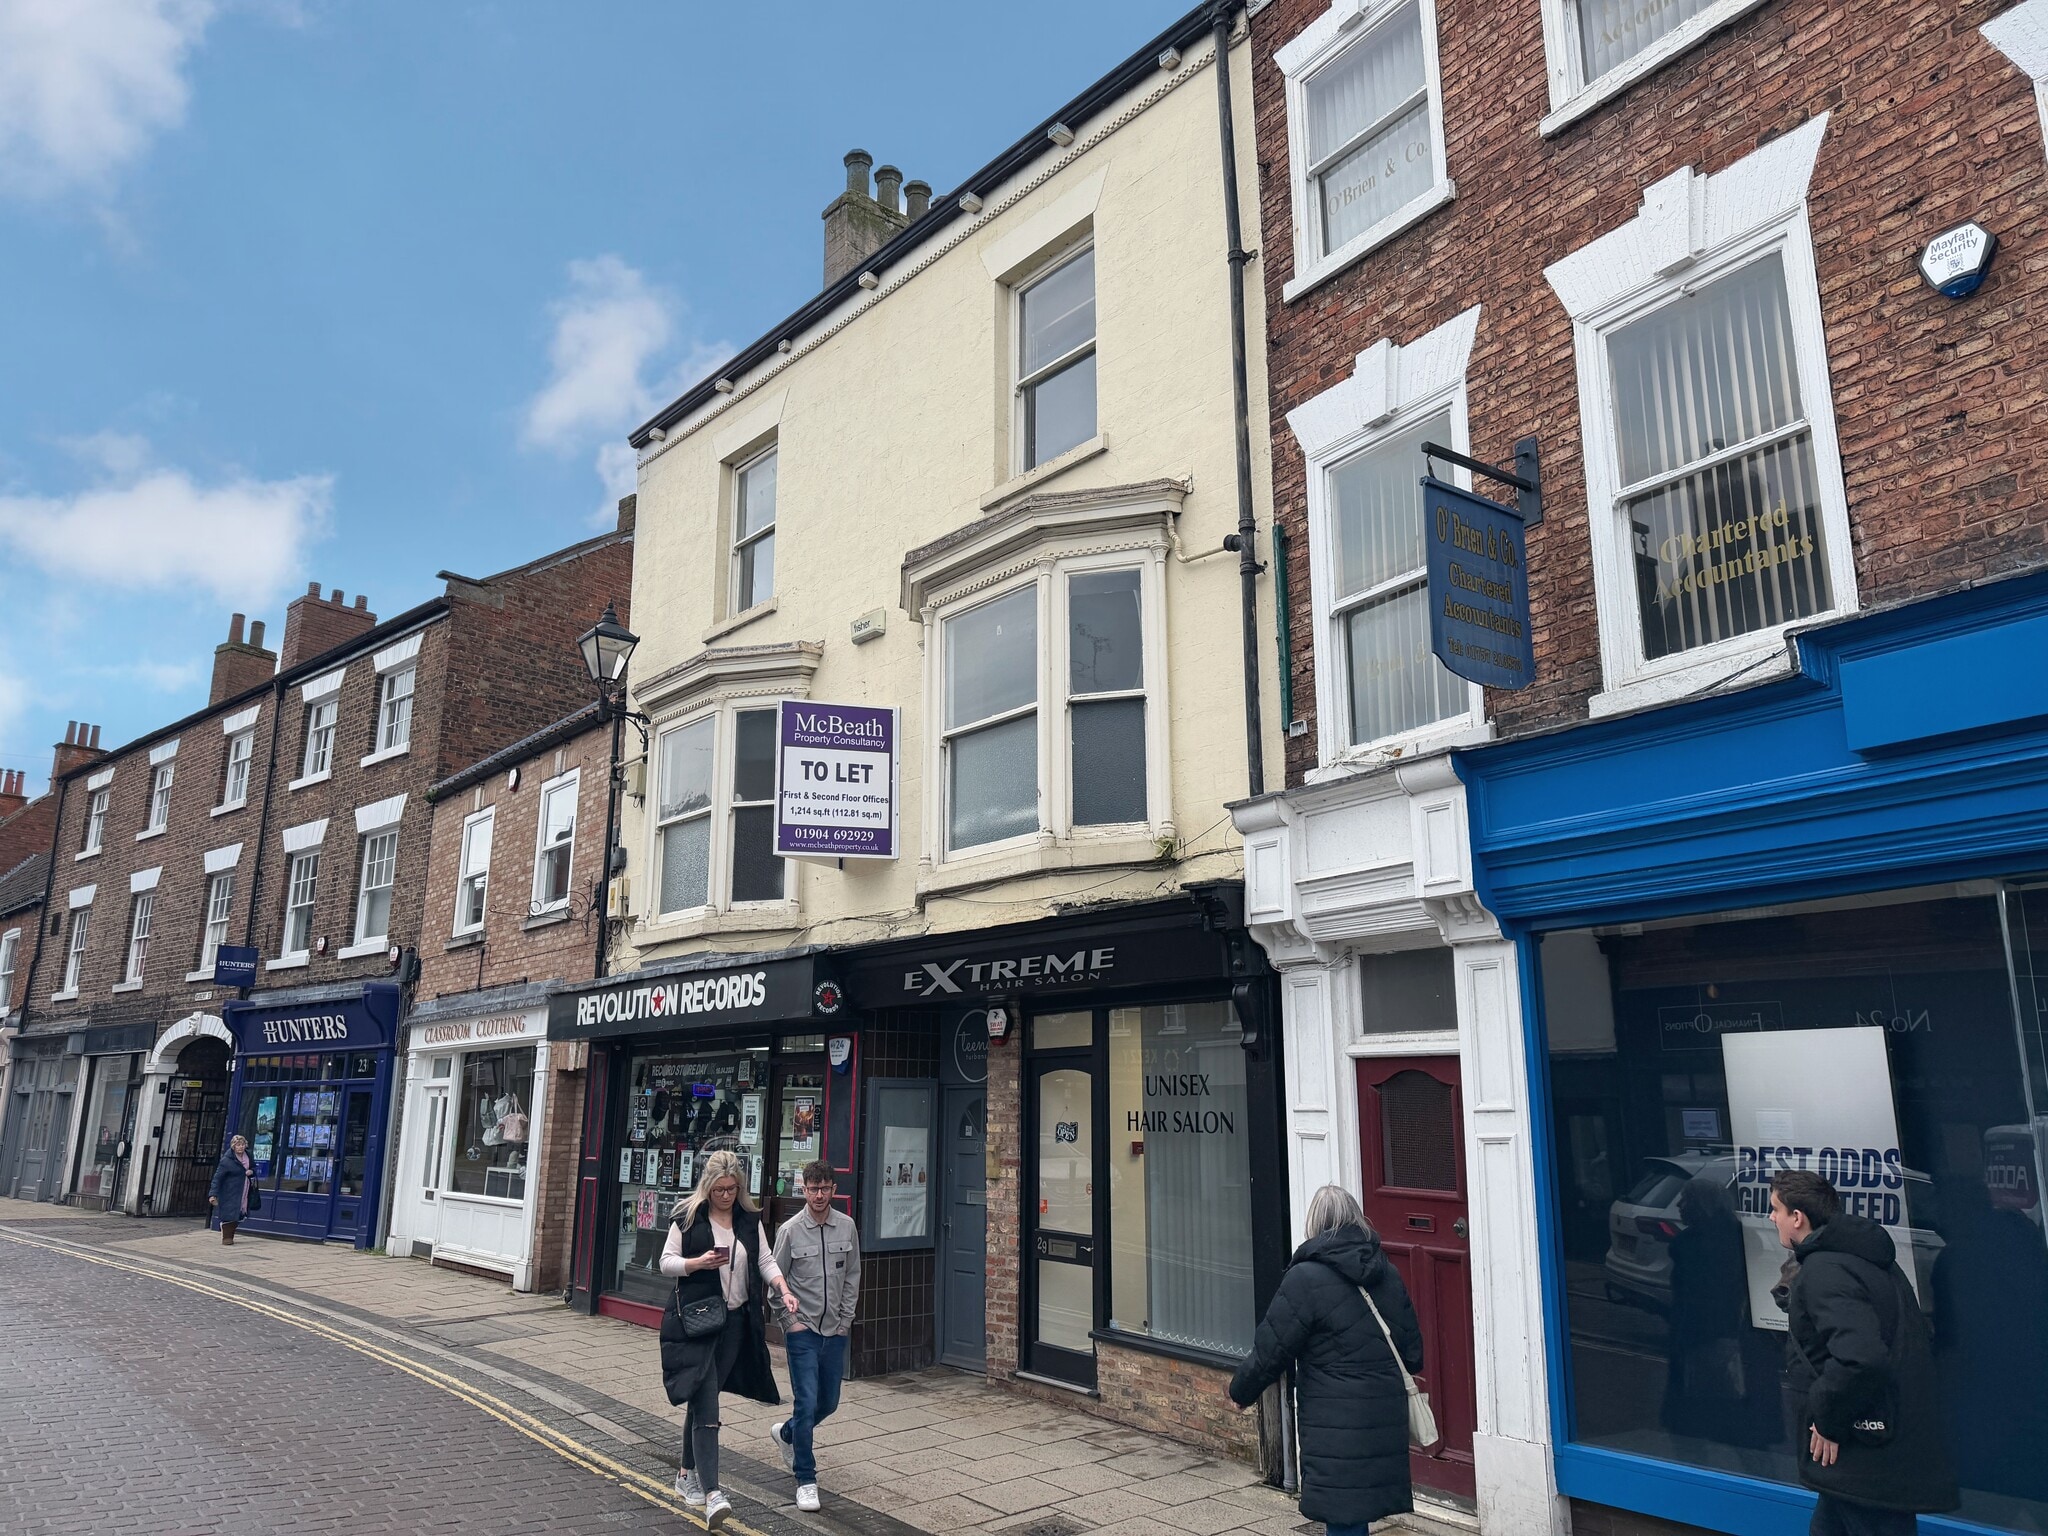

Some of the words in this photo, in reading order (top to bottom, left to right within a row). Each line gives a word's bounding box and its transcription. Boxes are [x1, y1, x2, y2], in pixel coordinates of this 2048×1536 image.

[1328, 175, 1376, 216] O'Brien
[1385, 157, 1396, 178] &
[1405, 142, 1428, 163] Co.
[1930, 238, 1978, 264] Security
[1931, 228, 1975, 254] Mayfair
[1660, 498, 1789, 563] Chartered
[1487, 524, 1497, 561] &
[1500, 529, 1518, 569] Co.
[1652, 533, 1814, 605] Accountants
[1449, 562, 1512, 604] Chartered
[1444, 594, 1522, 639] Accountants
[795, 712, 884, 737] McBeath
[794, 733, 831, 745] Property
[833, 736, 885, 749] Consultancy
[801, 760, 828, 781] TO
[835, 763, 873, 784] LET
[784, 791, 801, 800] First
[804, 792, 809, 800] &
[812, 792, 840, 802] Second
[842, 794, 861, 803] Floor
[863, 795, 889, 804] Offices
[790, 806, 811, 816] 1,214
[813, 807, 830, 817] sq.ft
[862, 810, 882, 820] sq.m)
[795, 828, 829, 840] 01904
[834, 830, 874, 841] 692929
[789, 841, 879, 852] www.mcbeathproperty.co.uk
[219, 960, 256, 969] HUNTERS
[815, 981, 842, 999] REVOLUTION
[979, 979, 1024, 991] HAIR
[1034, 971, 1101, 986] SALON
[577, 984, 679, 1026] REVOLUTION
[680, 971, 766, 1014] RECORDS
[816, 1000, 839, 1014] RECORDS
[263, 1014, 348, 1044] HUNTERS
[424, 1023, 471, 1044] CLASSROOM
[476, 1015, 527, 1037] CLOTHING
[357, 1058, 368, 1072] 23
[652, 1064, 676, 1077] RECORD
[676, 1064, 697, 1076] STORE
[696, 1063, 708, 1075] DAY
[1146, 1074, 1210, 1097] UNISEX
[1057, 1127, 1076, 1141] OPEN
[1127, 1111, 1167, 1133] HAIR
[1173, 1111, 1234, 1134] SALON
[1818, 1147, 1903, 1190] ODDS
[1037, 1236, 1048, 1254] 29
